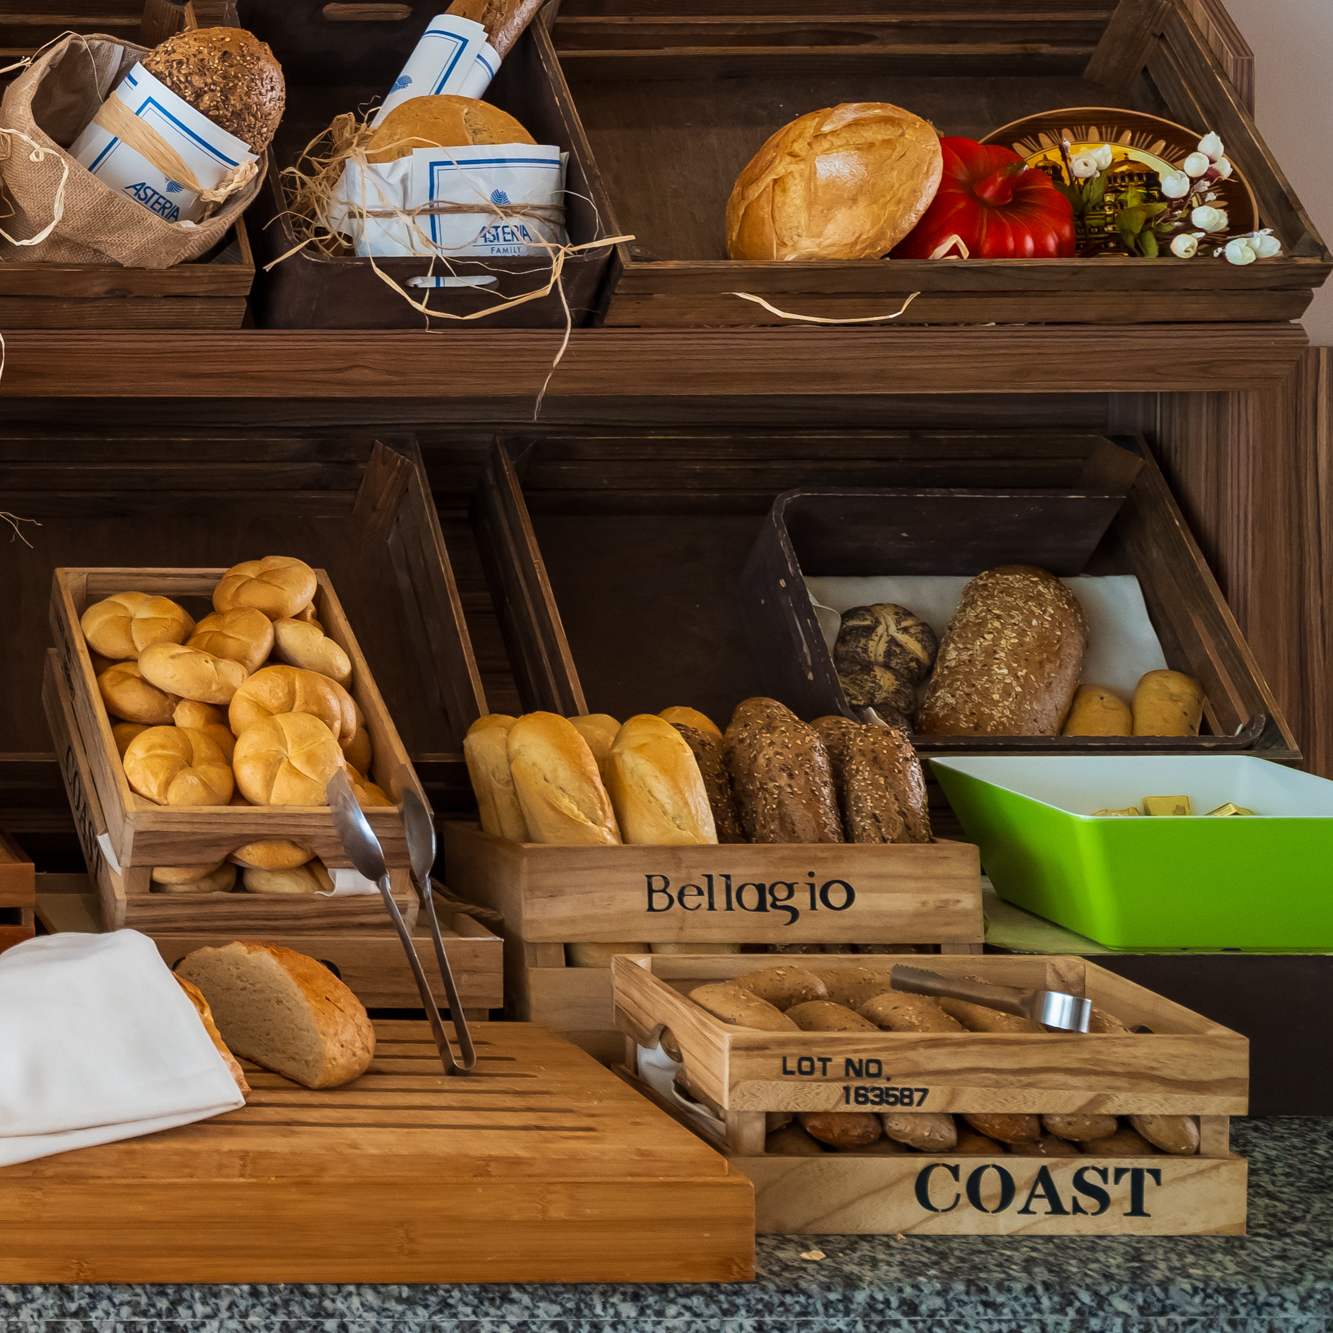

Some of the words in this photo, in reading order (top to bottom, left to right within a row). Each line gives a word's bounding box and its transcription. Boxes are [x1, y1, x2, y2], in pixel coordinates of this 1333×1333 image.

[124, 181, 180, 222] ASTERIA
[490, 246, 522, 255] FAMILY
[65, 745, 103, 881] COAST
[645, 871, 856, 926] Bellagio
[781, 1056, 833, 1078] LOT
[844, 1058, 892, 1082] NO.
[842, 1086, 930, 1107] 163587
[914, 1162, 1162, 1219] COAST
